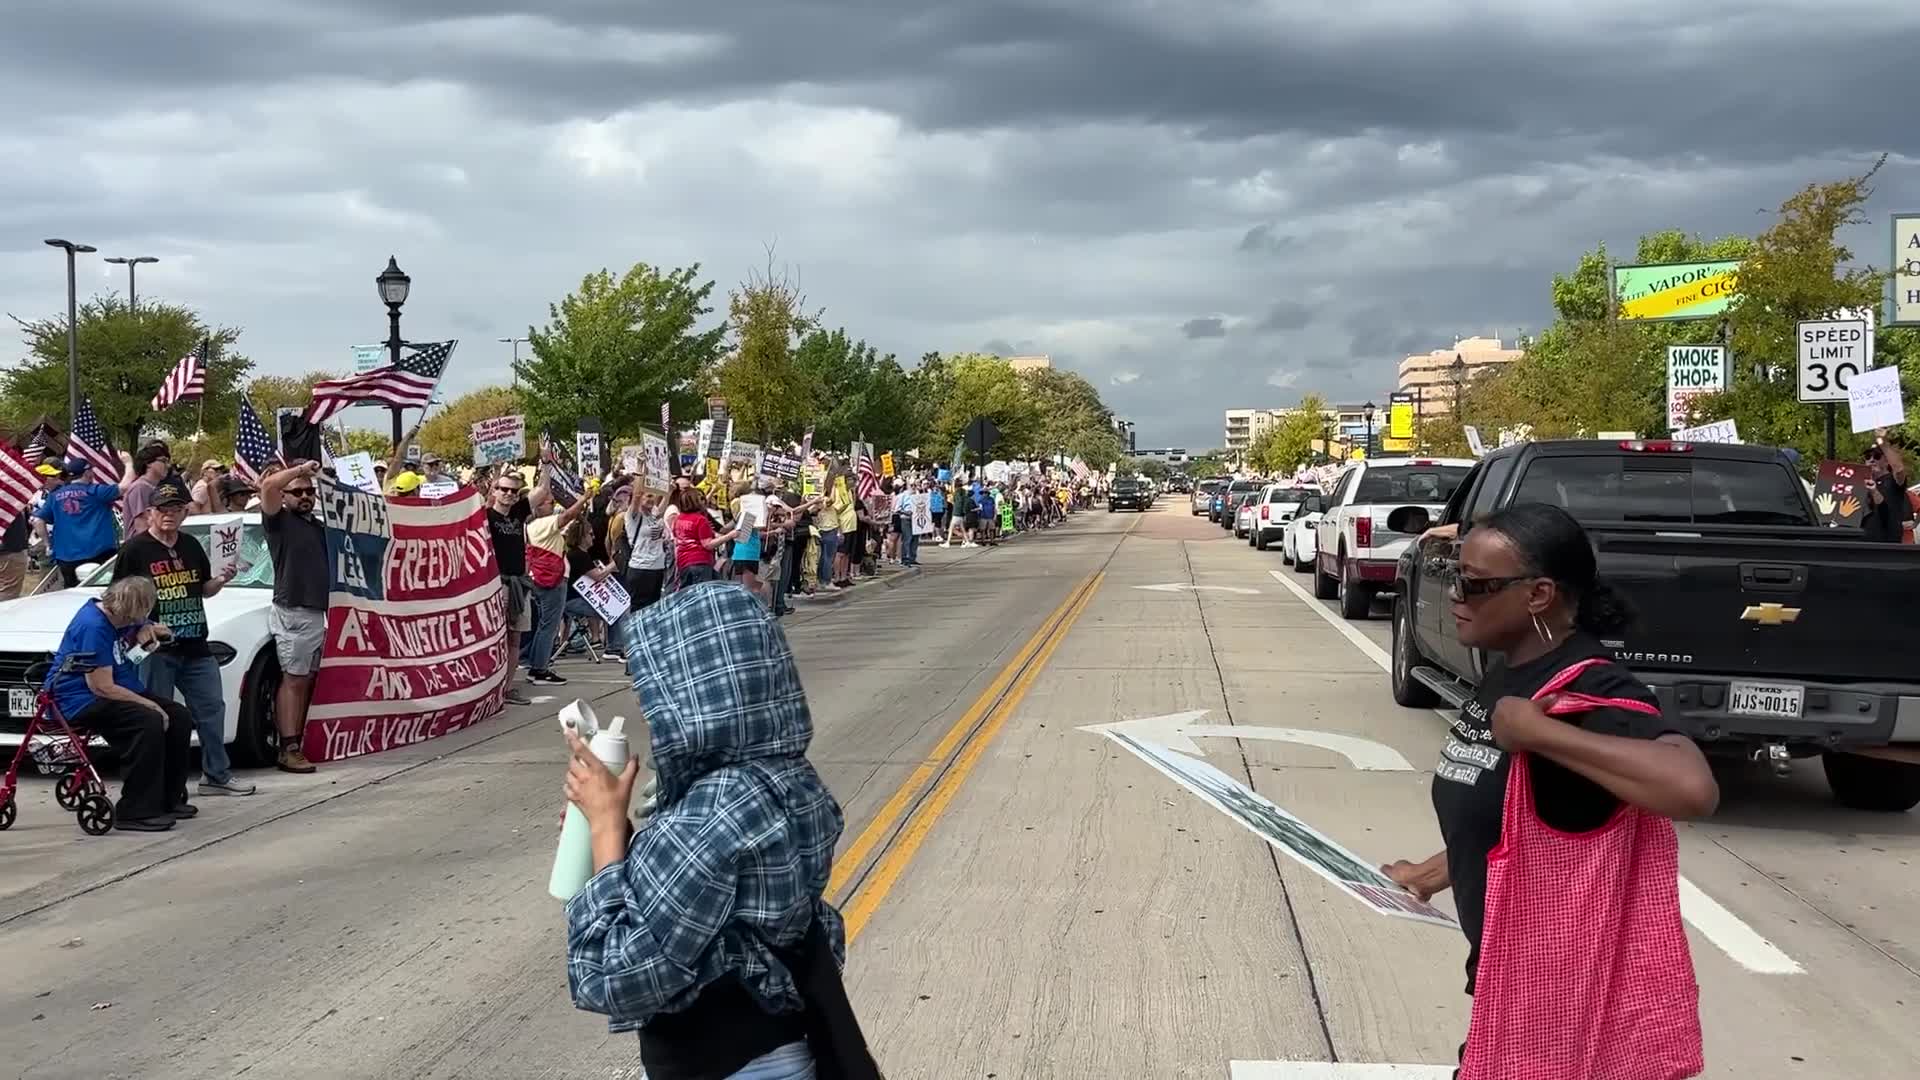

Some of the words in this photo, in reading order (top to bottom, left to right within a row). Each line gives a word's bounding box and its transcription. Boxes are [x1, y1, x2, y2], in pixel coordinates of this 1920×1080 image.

[1675, 294, 1697, 306] FINE
[1804, 330, 1861, 343] SPEED
[1672, 349, 1719, 367] SMOKE
[1810, 346, 1854, 359] LIMIT
[1806, 362, 1860, 392] 30
[222, 542, 237, 554] NO
[154, 570, 200, 587] TROUBLE
[156, 585, 188, 600] GOOD
[590, 580, 610, 604] MAGA
[380, 608, 476, 657] INJUSTICE
[1615, 652, 1693, 663] LVERADO
[365, 666, 413, 700] AND
[417, 664, 448, 695] WE
[445, 655, 486, 688] FALL
[323, 718, 376, 760] YOUR
[381, 711, 445, 750] VOICE
